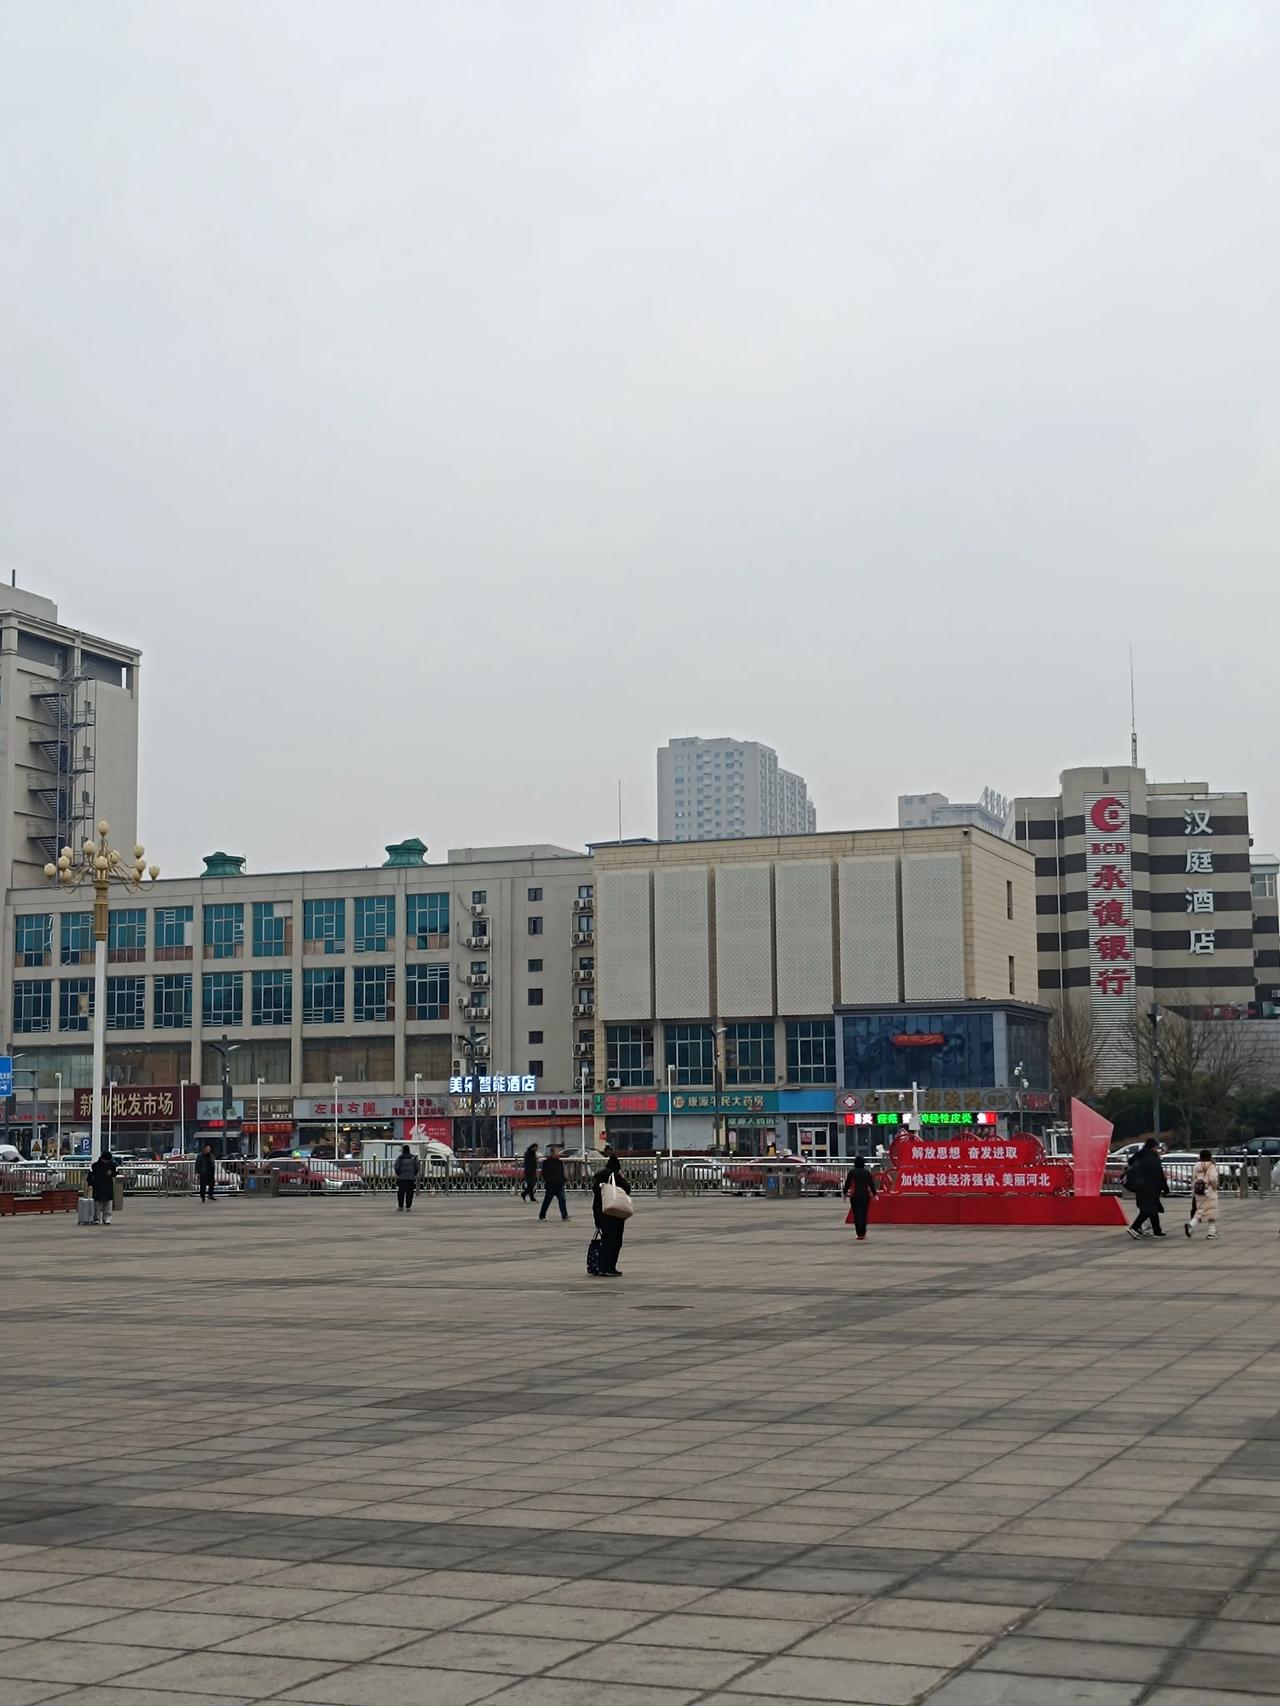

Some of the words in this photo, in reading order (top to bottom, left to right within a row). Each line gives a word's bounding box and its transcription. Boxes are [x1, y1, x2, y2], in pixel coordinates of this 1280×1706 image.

[1183, 808, 1215, 955] 汉庭酒店
[1092, 864, 1131, 995] 承德银行
[900, 1172, 1051, 1187] 加快建设经济强省、美丽河北
[911, 1146, 961, 1160] 解放思想
[968, 1146, 1018, 1160] 奋发进取
